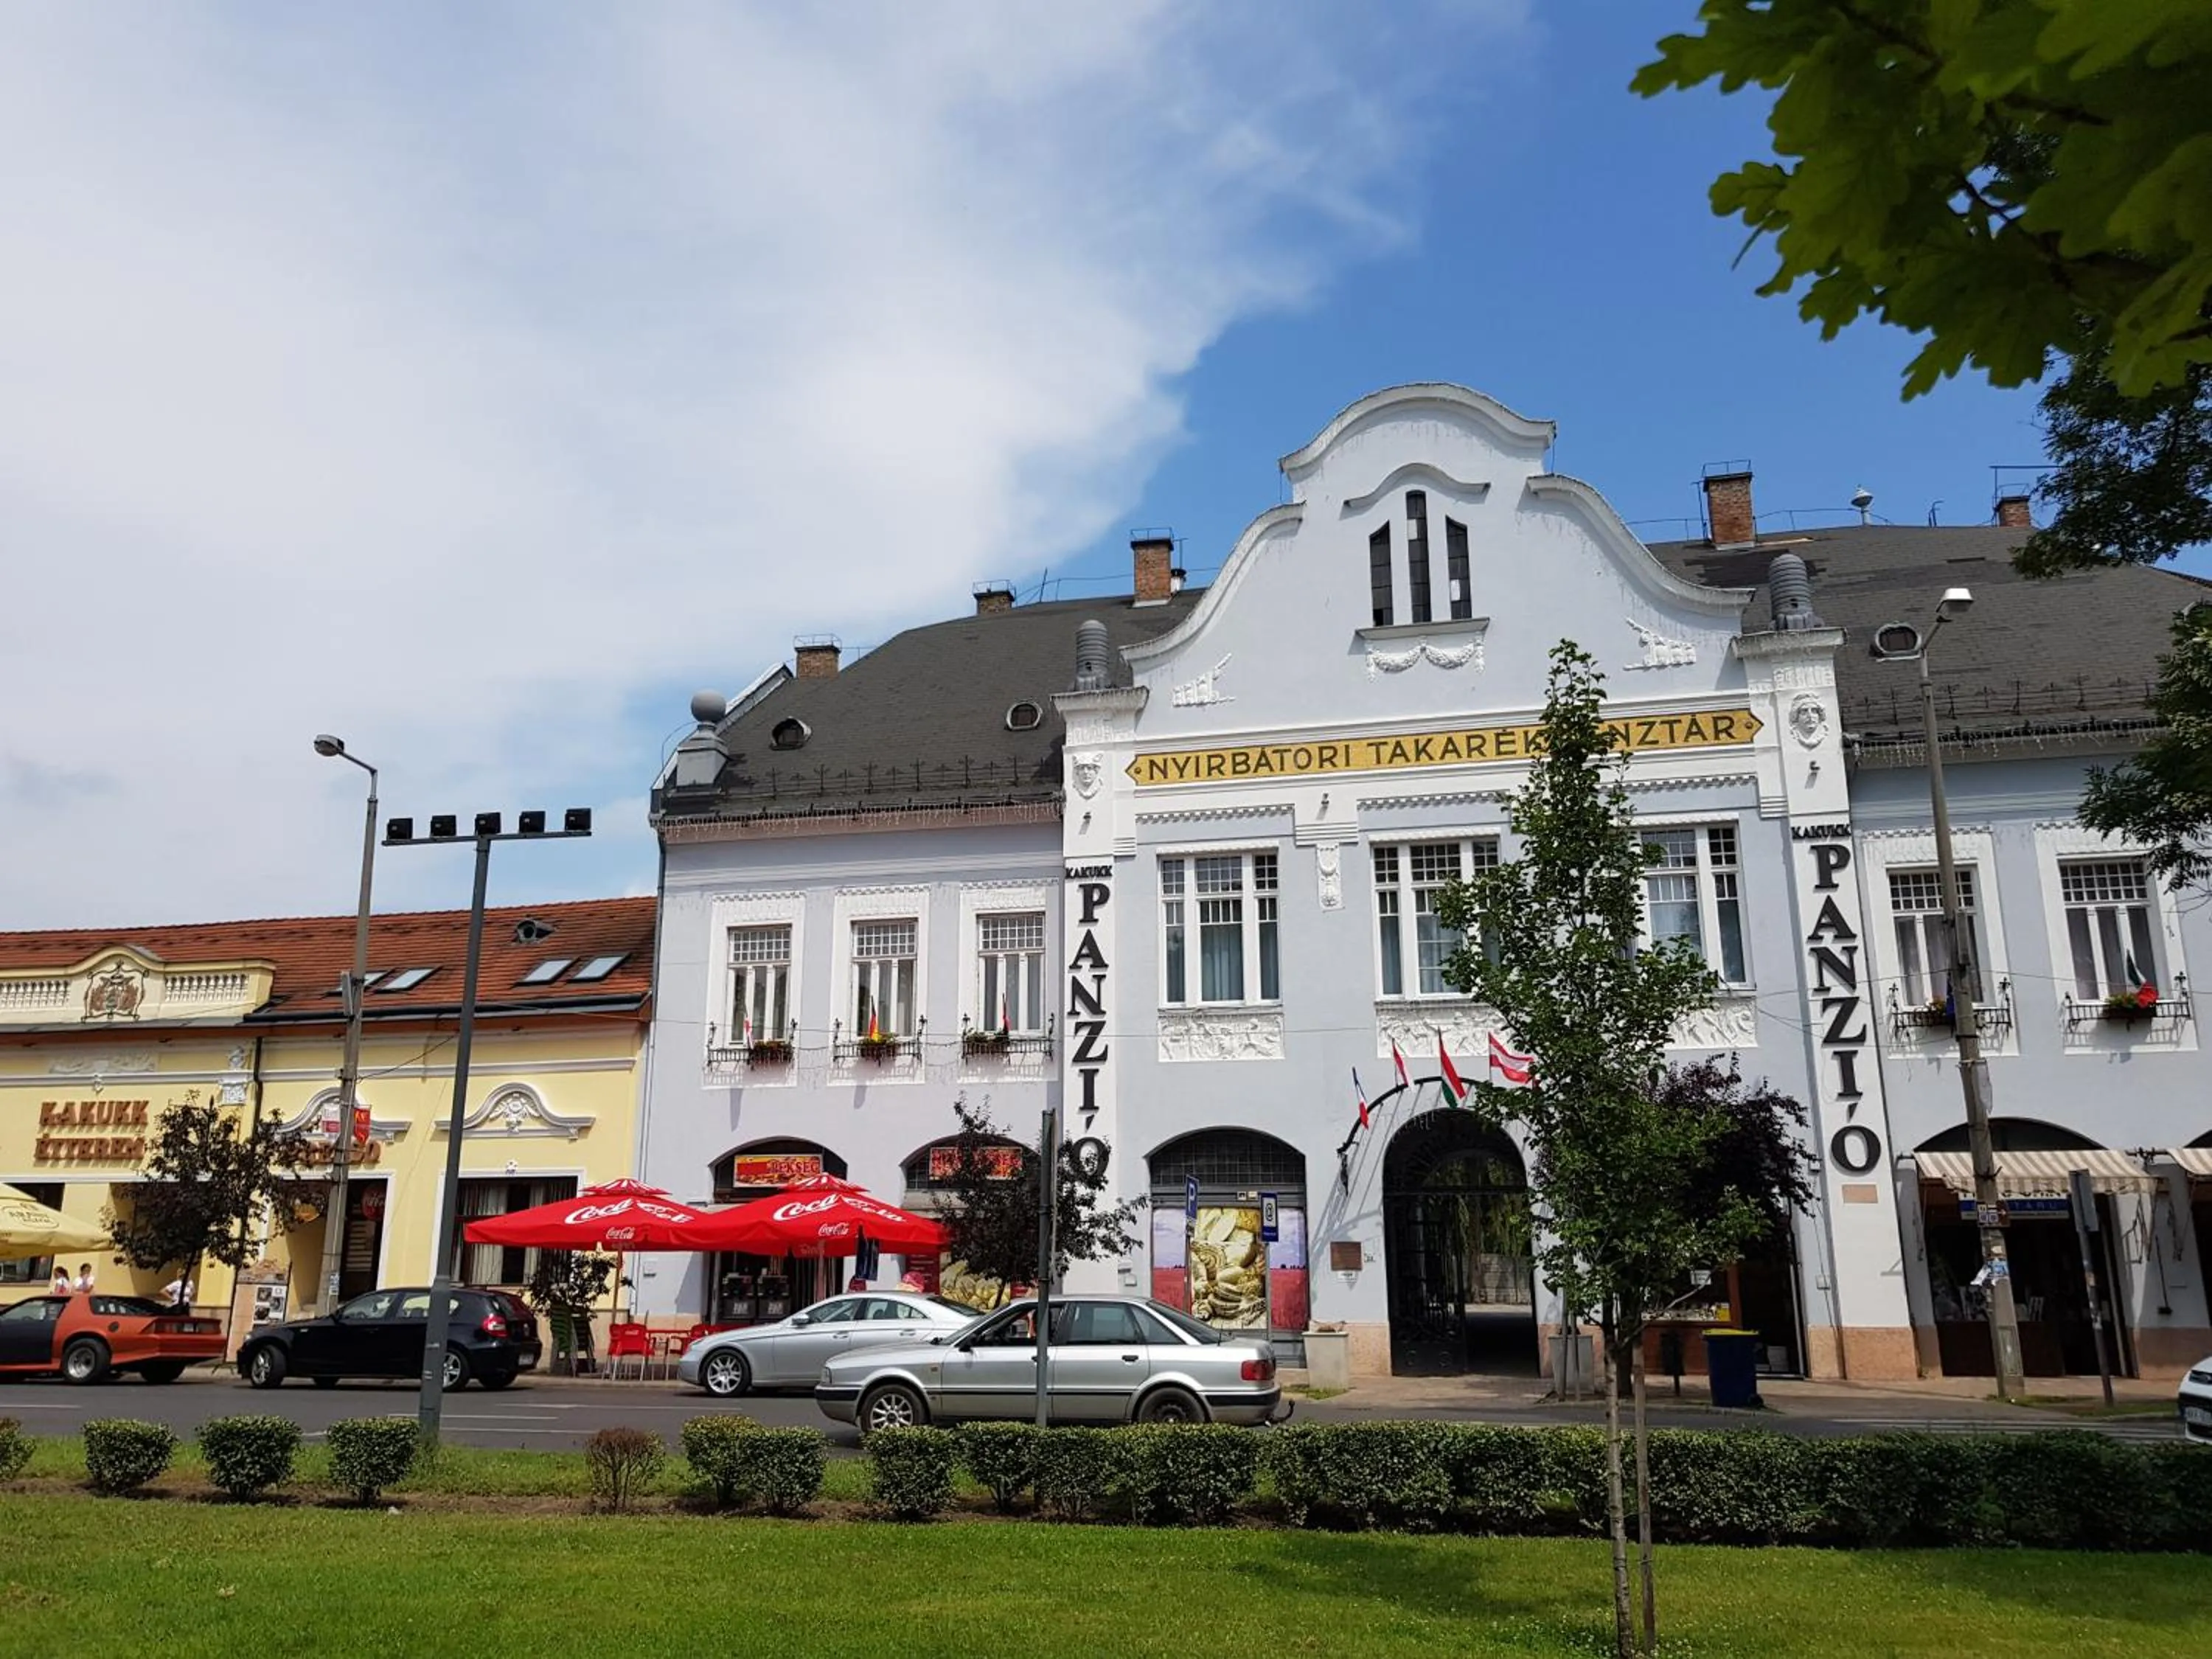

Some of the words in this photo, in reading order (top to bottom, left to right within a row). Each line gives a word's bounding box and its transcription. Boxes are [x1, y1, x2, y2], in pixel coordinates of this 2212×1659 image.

[1367, 713, 1736, 765] TAKARÉKNZTÁR
[1791, 824, 1852, 840] KAKUKK
[1065, 866, 1113, 880] KAKUKK
[1807, 844, 1882, 1172] PANZIÓ
[39, 1100, 150, 1126] KAKUKK
[34, 1133, 145, 1160] ÉTTEREM
[1188, 1183, 1196, 1212] P
